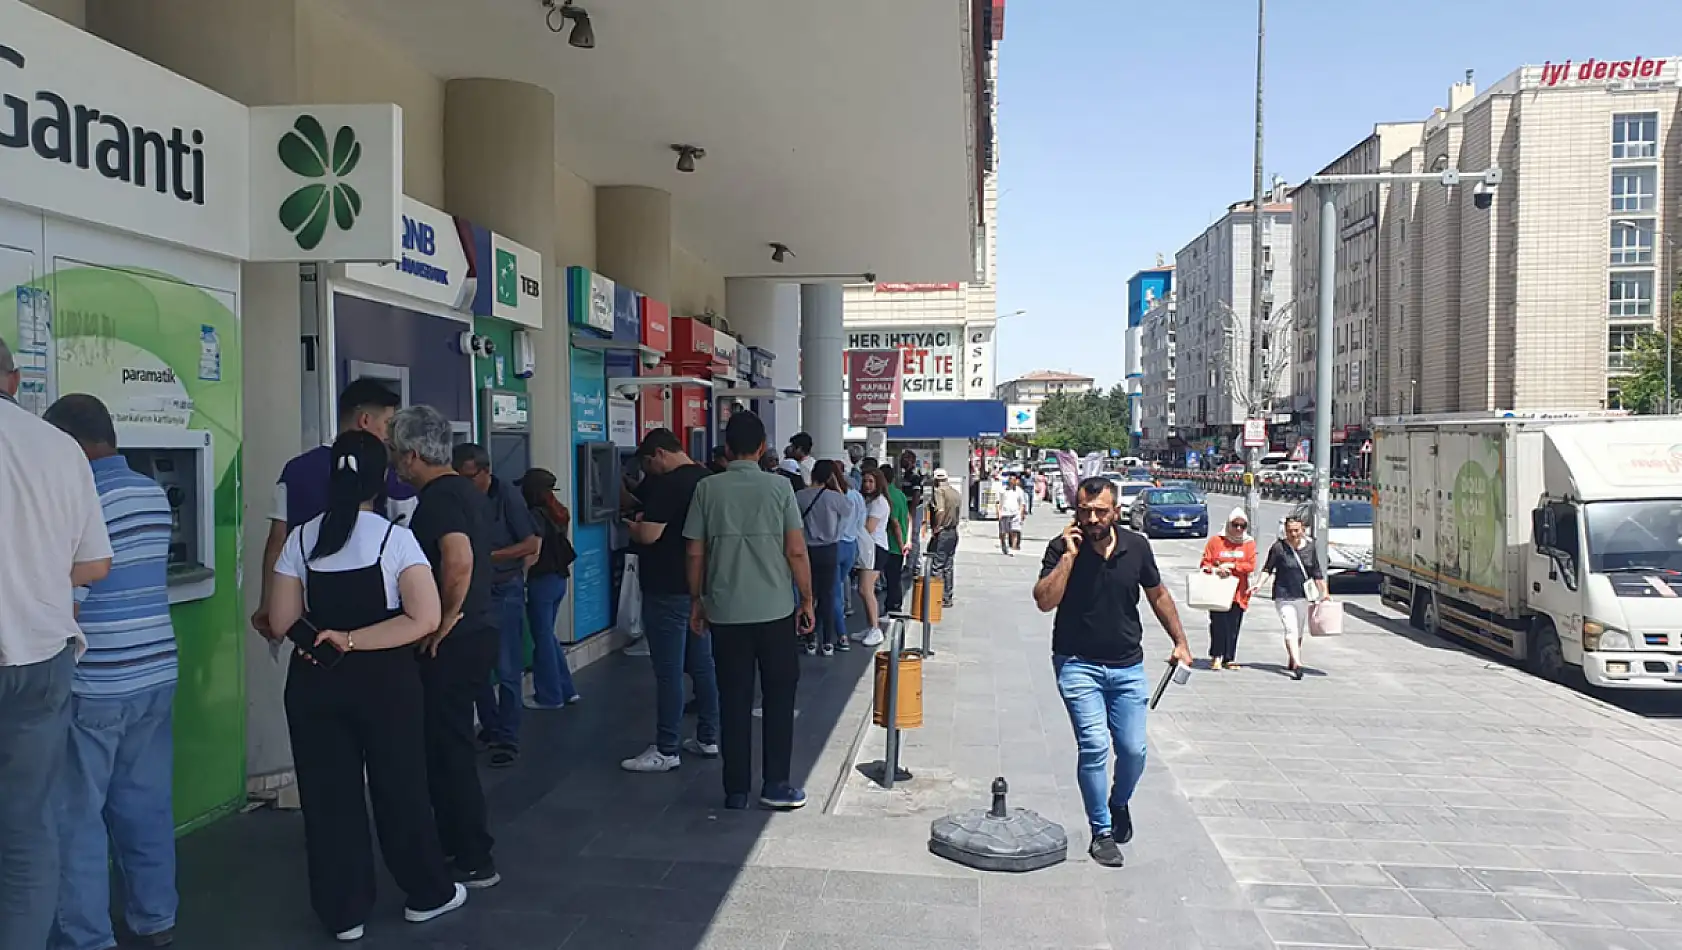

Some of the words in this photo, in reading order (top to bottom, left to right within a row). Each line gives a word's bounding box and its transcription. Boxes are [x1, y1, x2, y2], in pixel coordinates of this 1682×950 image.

[1541, 60, 1571, 86] iyi
[1578, 56, 1667, 80] dersler
[521, 275, 539, 297] TEB
[849, 334, 879, 348] HER
[935, 355, 953, 375] TE
[122, 367, 176, 384] paramatik
[861, 382, 892, 392] KAPALI
[903, 377, 953, 392] KSİTLE
[855, 392, 897, 401] OTOPARK
